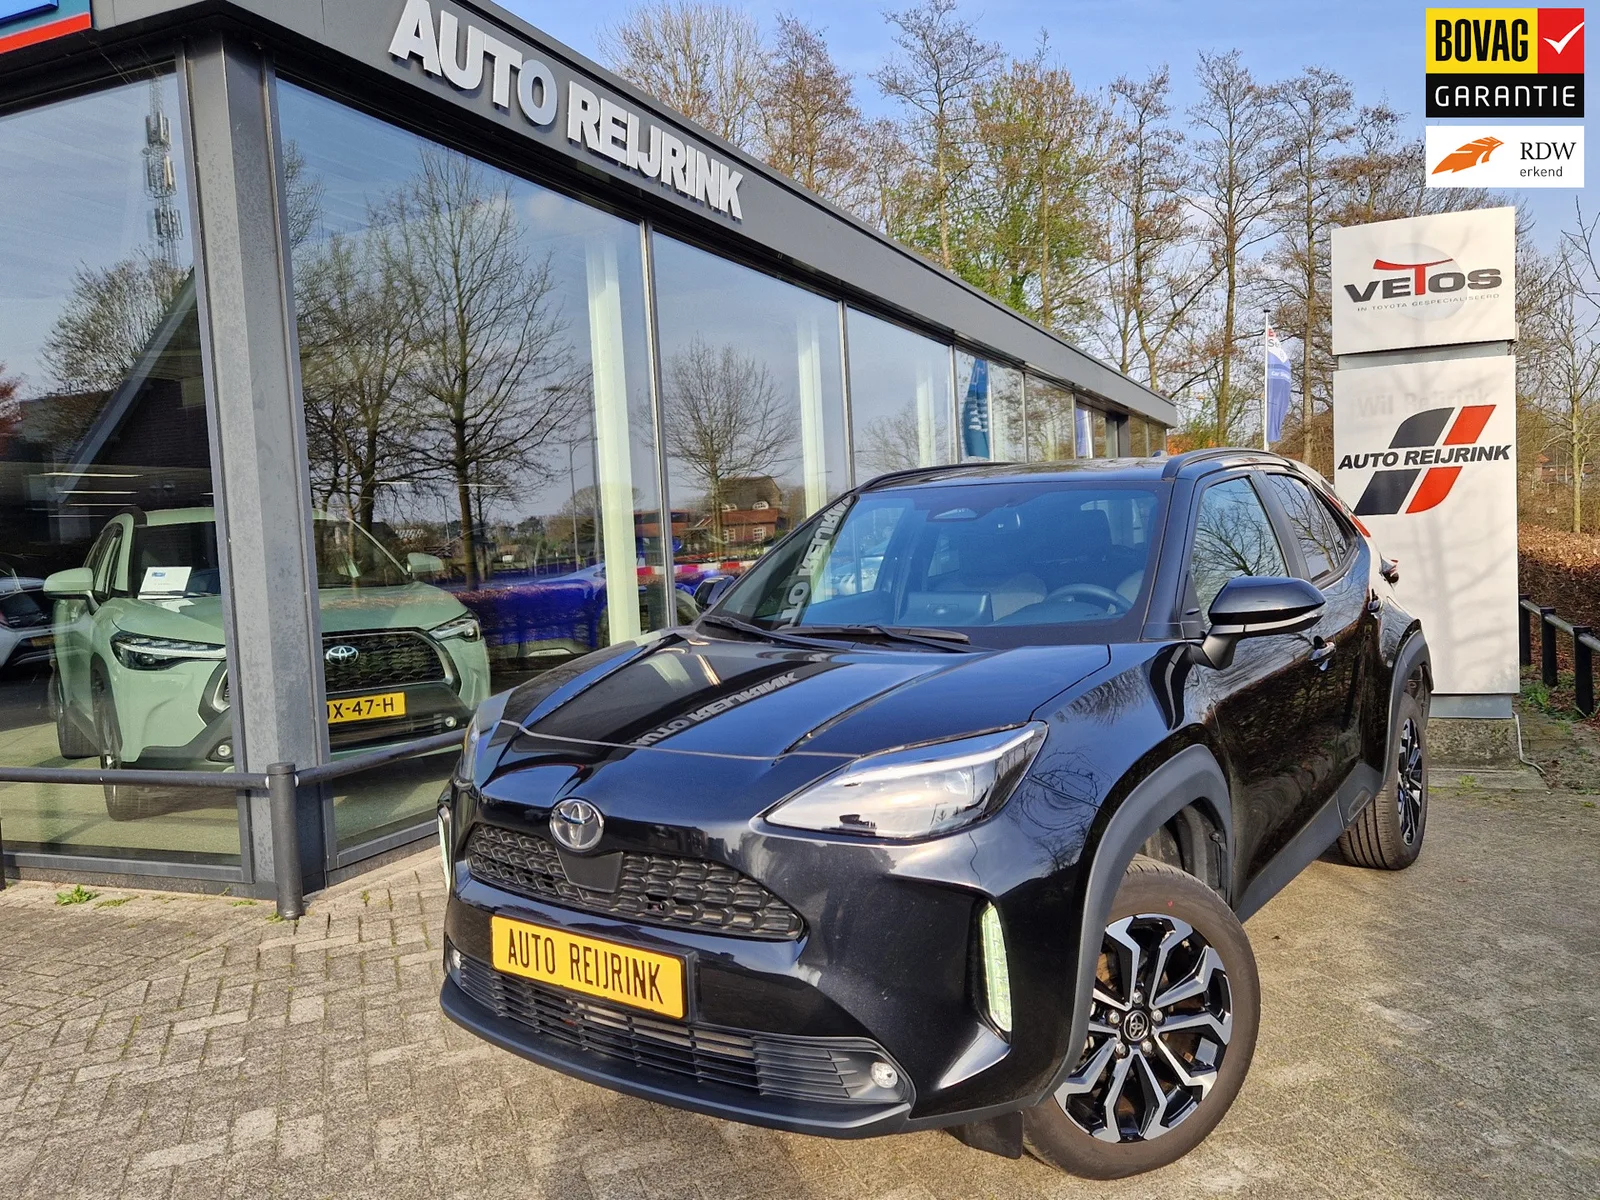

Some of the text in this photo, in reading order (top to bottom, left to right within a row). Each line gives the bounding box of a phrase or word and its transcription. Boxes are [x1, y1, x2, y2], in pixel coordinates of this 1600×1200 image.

[388, 0, 743, 219] AUTO REIJRINK
[1344, 258, 1503, 303] VETOS
[1411, 293, 1500, 307] GESPECIALISEERD
[1337, 445, 1512, 470] AUTO REIJRINK
[508, 928, 664, 1005] AUTO REIJRINK
